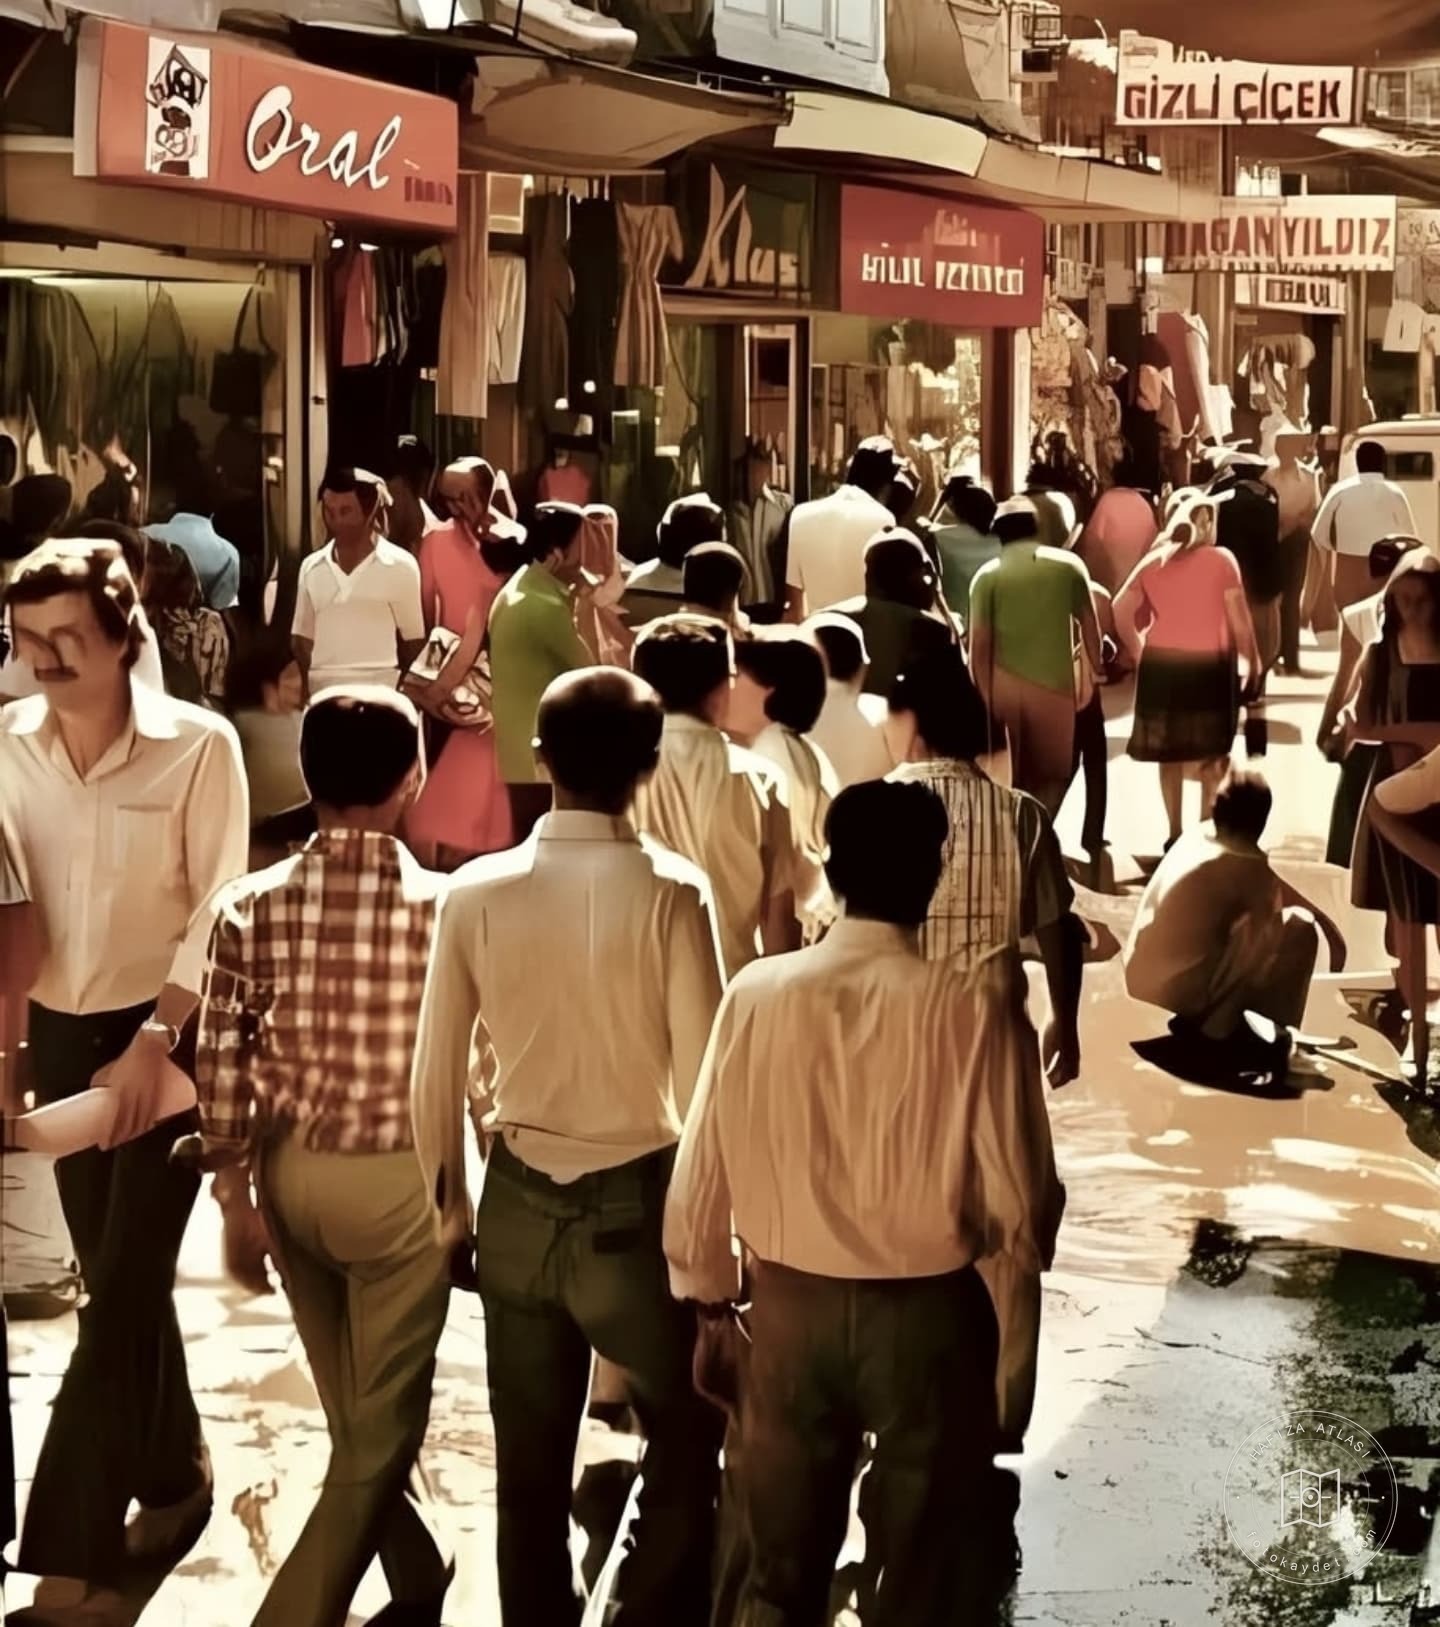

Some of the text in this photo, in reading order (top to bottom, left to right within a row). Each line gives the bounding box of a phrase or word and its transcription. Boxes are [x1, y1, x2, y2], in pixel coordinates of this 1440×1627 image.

[1124, 68, 1341, 124] GİZLİ ÇİÇEK
[246, 85, 402, 190] Oral
